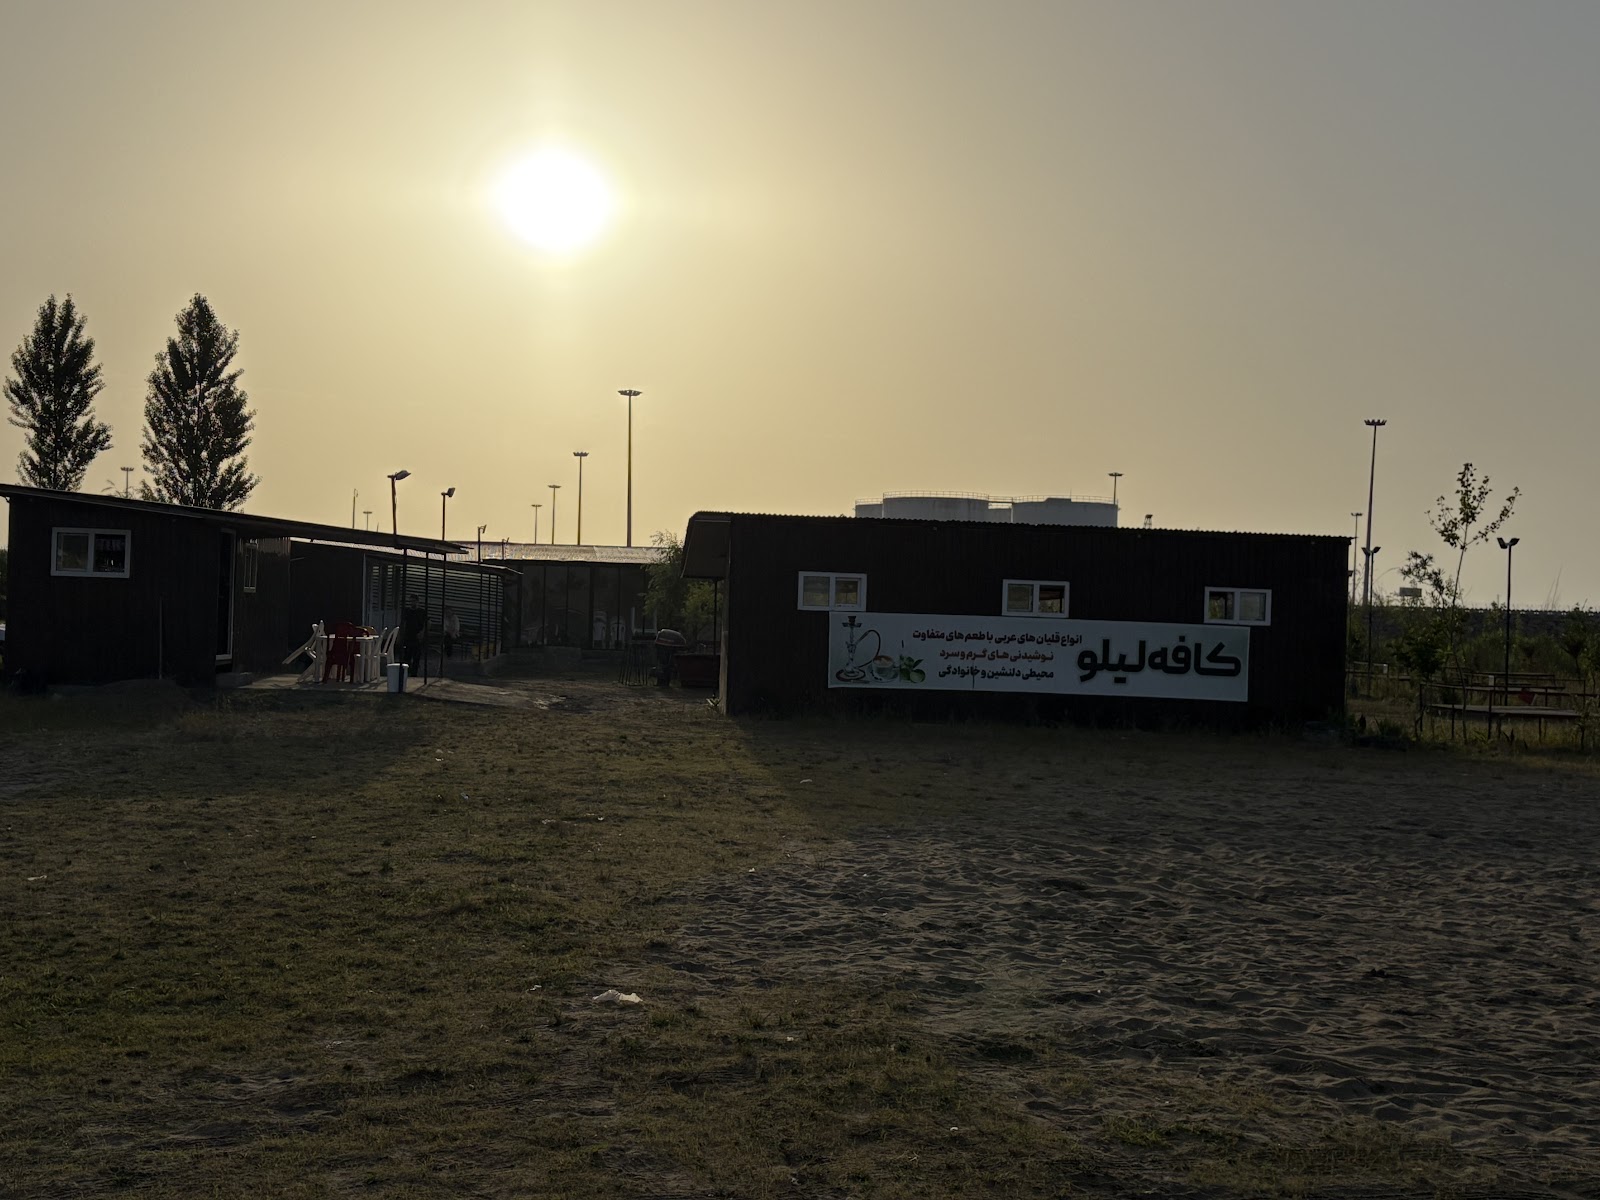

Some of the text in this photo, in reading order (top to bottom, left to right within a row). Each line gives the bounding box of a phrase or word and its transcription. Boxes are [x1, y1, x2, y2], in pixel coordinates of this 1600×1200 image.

[912, 629, 945, 641] متفاوت
[986, 631, 994, 644] با
[994, 633, 1017, 644] عربی
[1061, 634, 1082, 647] انواع
[1077, 635, 1242, 684] کافه لیلو
[938, 664, 980, 678] خانوادگی
[986, 666, 1021, 680] دلنشین
[1021, 668, 1054, 681] محیطی
